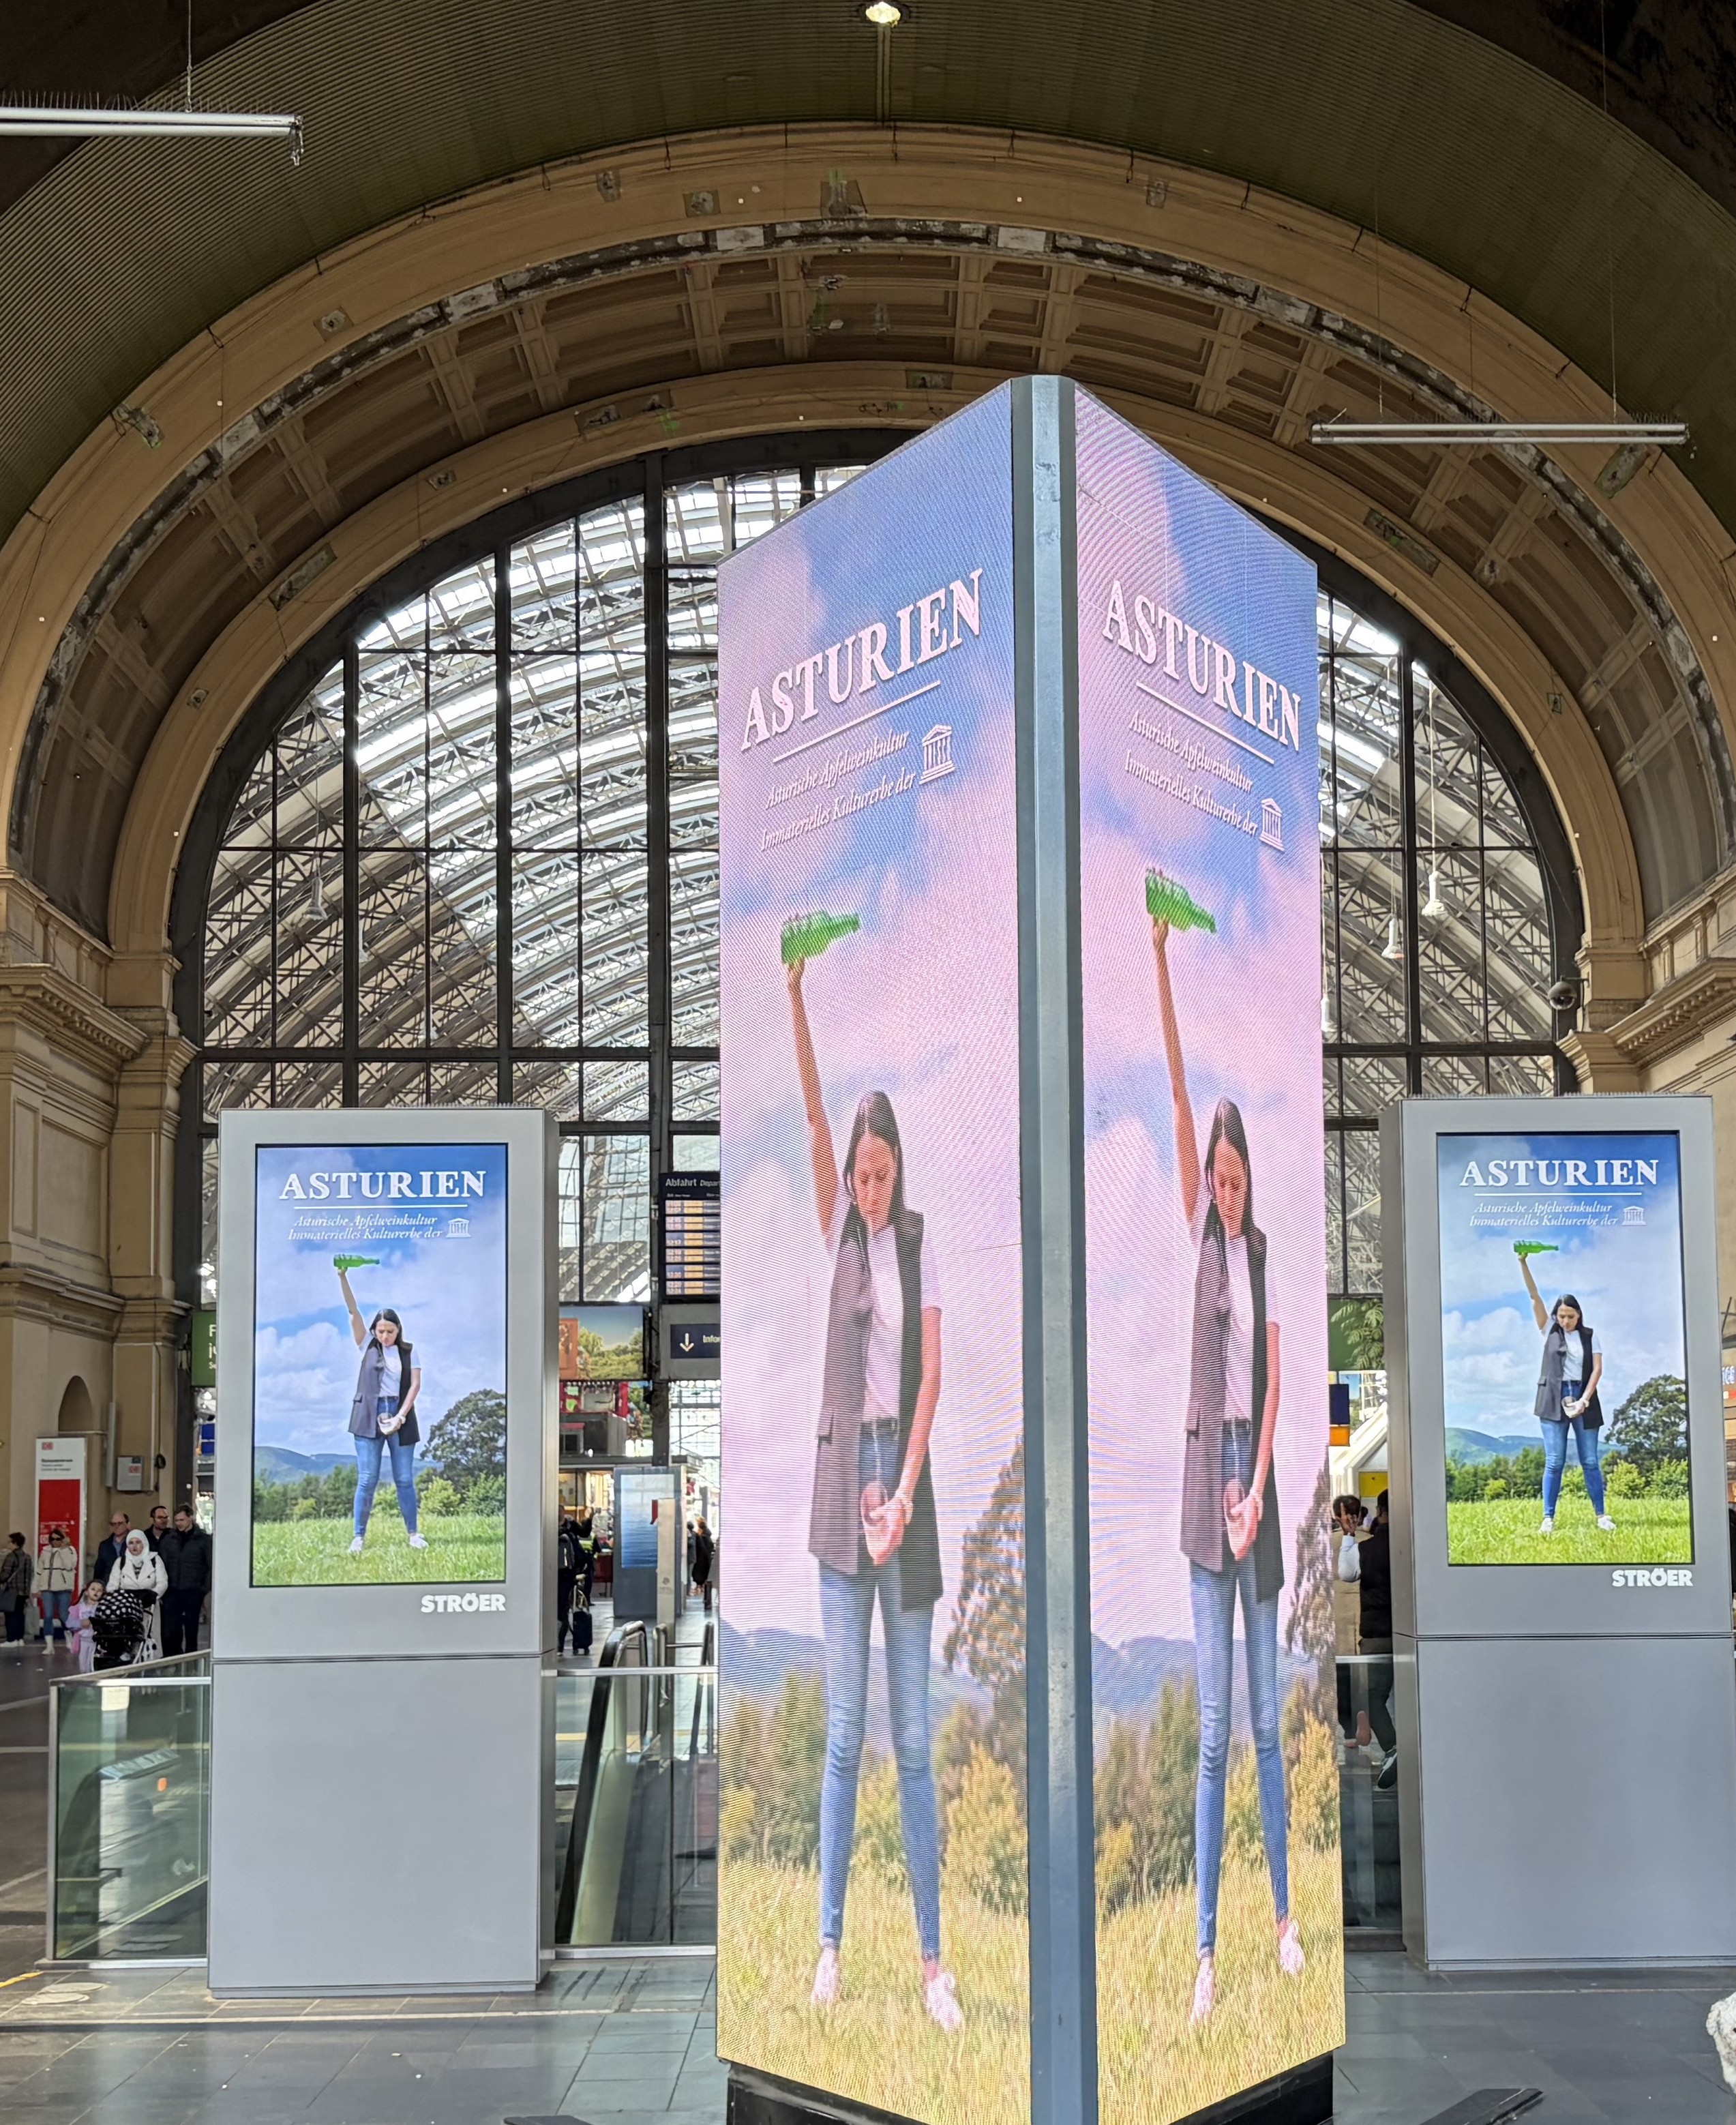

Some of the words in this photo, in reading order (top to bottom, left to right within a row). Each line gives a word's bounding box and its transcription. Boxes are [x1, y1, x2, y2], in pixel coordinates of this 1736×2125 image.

[741, 568, 983, 751] ASTURIEN
[1103, 580, 1301, 751] ASTURIEN
[1128, 709, 1179, 754] Asturische
[1180, 738, 1253, 793] Apfelweinkultur
[765, 768, 818, 810] Asturische
[820, 728, 909, 790] Apfelweinkultur
[1124, 749, 1191, 803] Immaterielles
[1193, 786, 1242, 828] Kulturerbe
[1242, 810, 1258, 836] der
[761, 803, 830, 852] Immaterielles
[834, 775, 894, 821] Kulturerbe
[895, 767, 916, 794] der
[279, 1170, 487, 1200] ASTURIEN
[665, 1178, 697, 1187] Abfahrt
[1459, 1159, 1660, 1187] ASTURIEN
[294, 1215, 348, 1227] Asturische
[350, 1213, 438, 1230] Apfelweinkultur
[1469, 1214, 1540, 1226] Immaterielles
[1542, 1214, 1599, 1226] Kulturerbe
[1600, 1214, 1619, 1226] der
[1473, 1201, 1527, 1213] Asturische
[1529, 1200, 1613, 1216] Apfelweinkultur
[288, 1228, 361, 1240] Immaterielles
[363, 1226, 420, 1239] Kulturerbe
[423, 1226, 443, 1238] der
[1612, 1567, 1694, 1587] STRÖER
[421, 1592, 506, 1613] STRÖER
